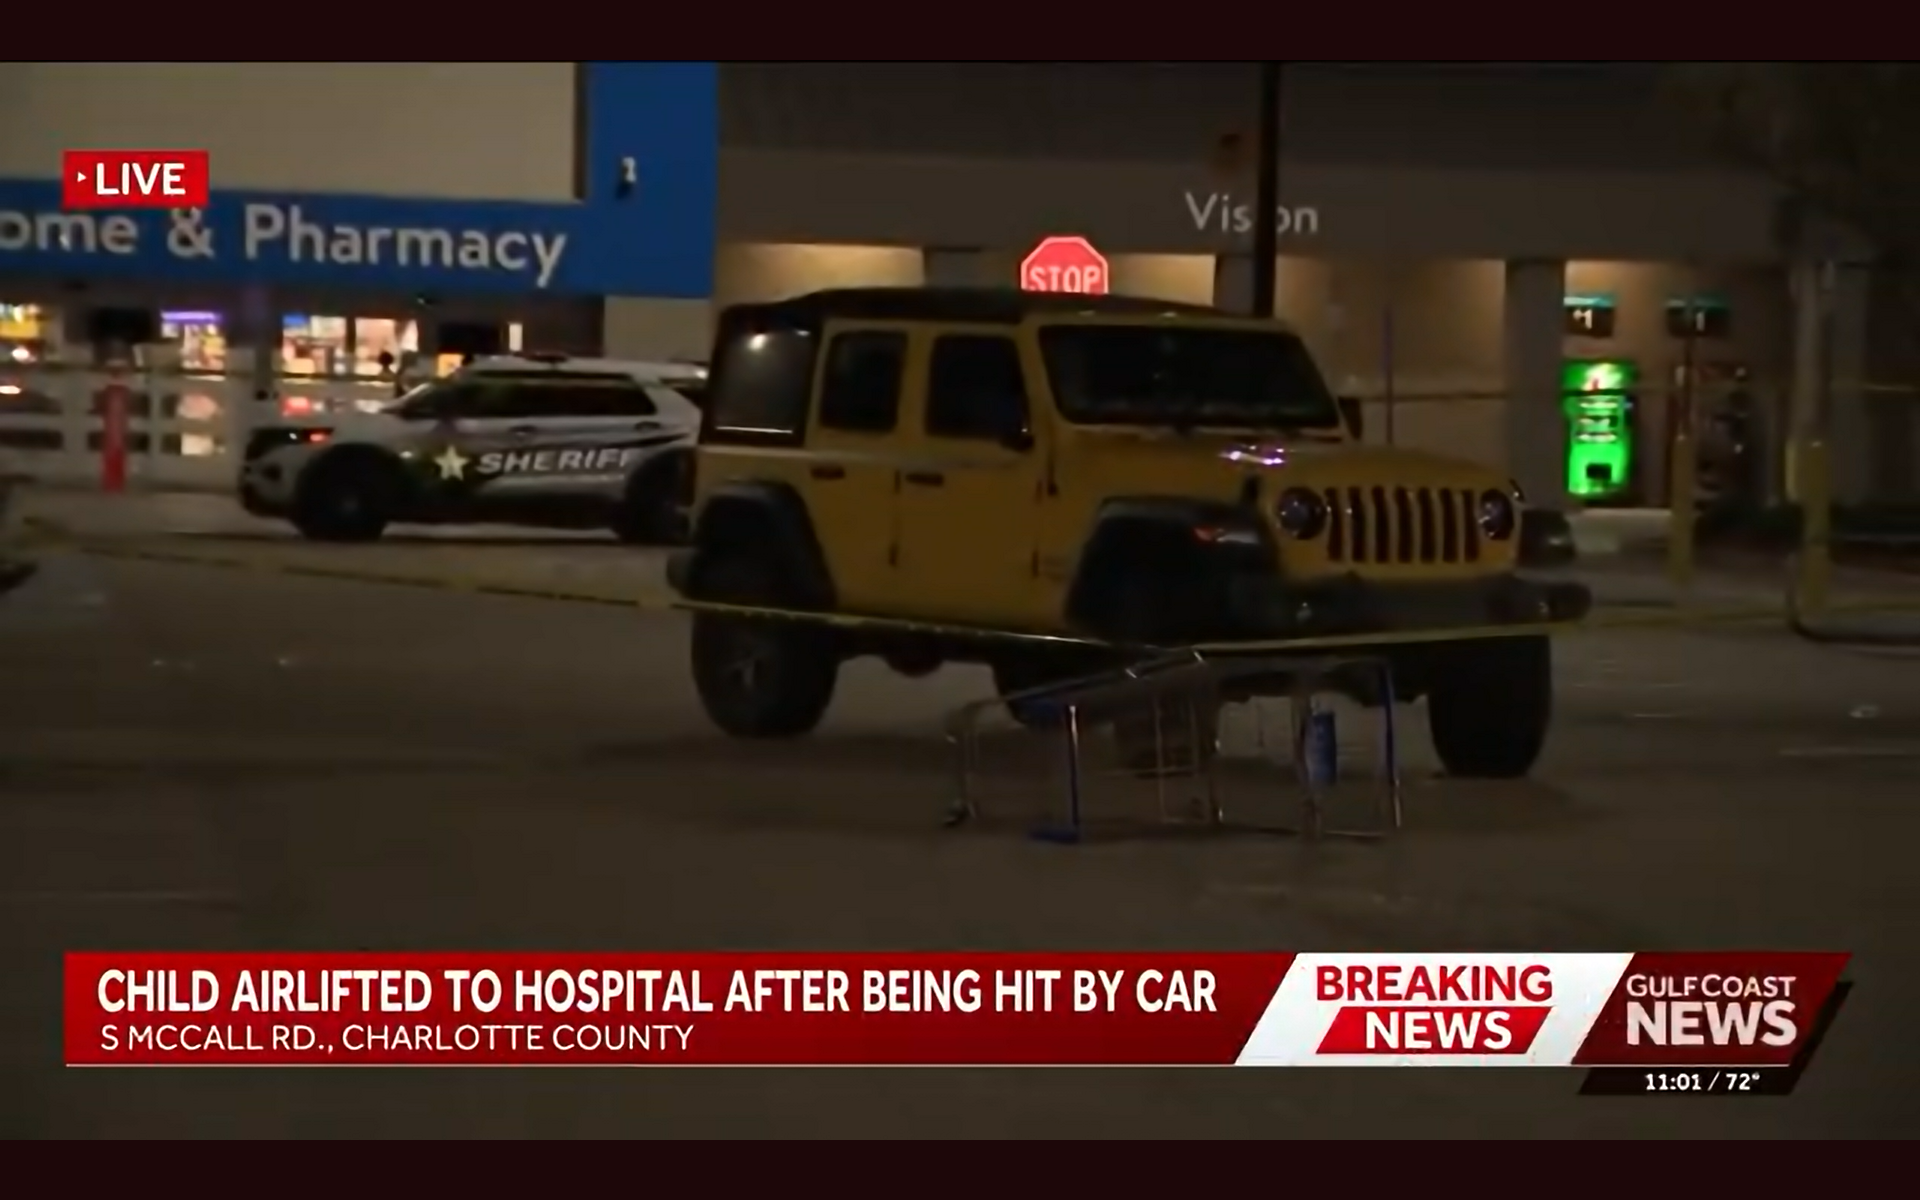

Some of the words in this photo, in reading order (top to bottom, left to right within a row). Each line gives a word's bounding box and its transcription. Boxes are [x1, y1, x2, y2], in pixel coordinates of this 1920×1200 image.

[1185, 191, 1319, 233] Vison
[166, 207, 214, 257] &
[243, 203, 568, 289] Pharmacy
[1029, 266, 1101, 293] STOP
